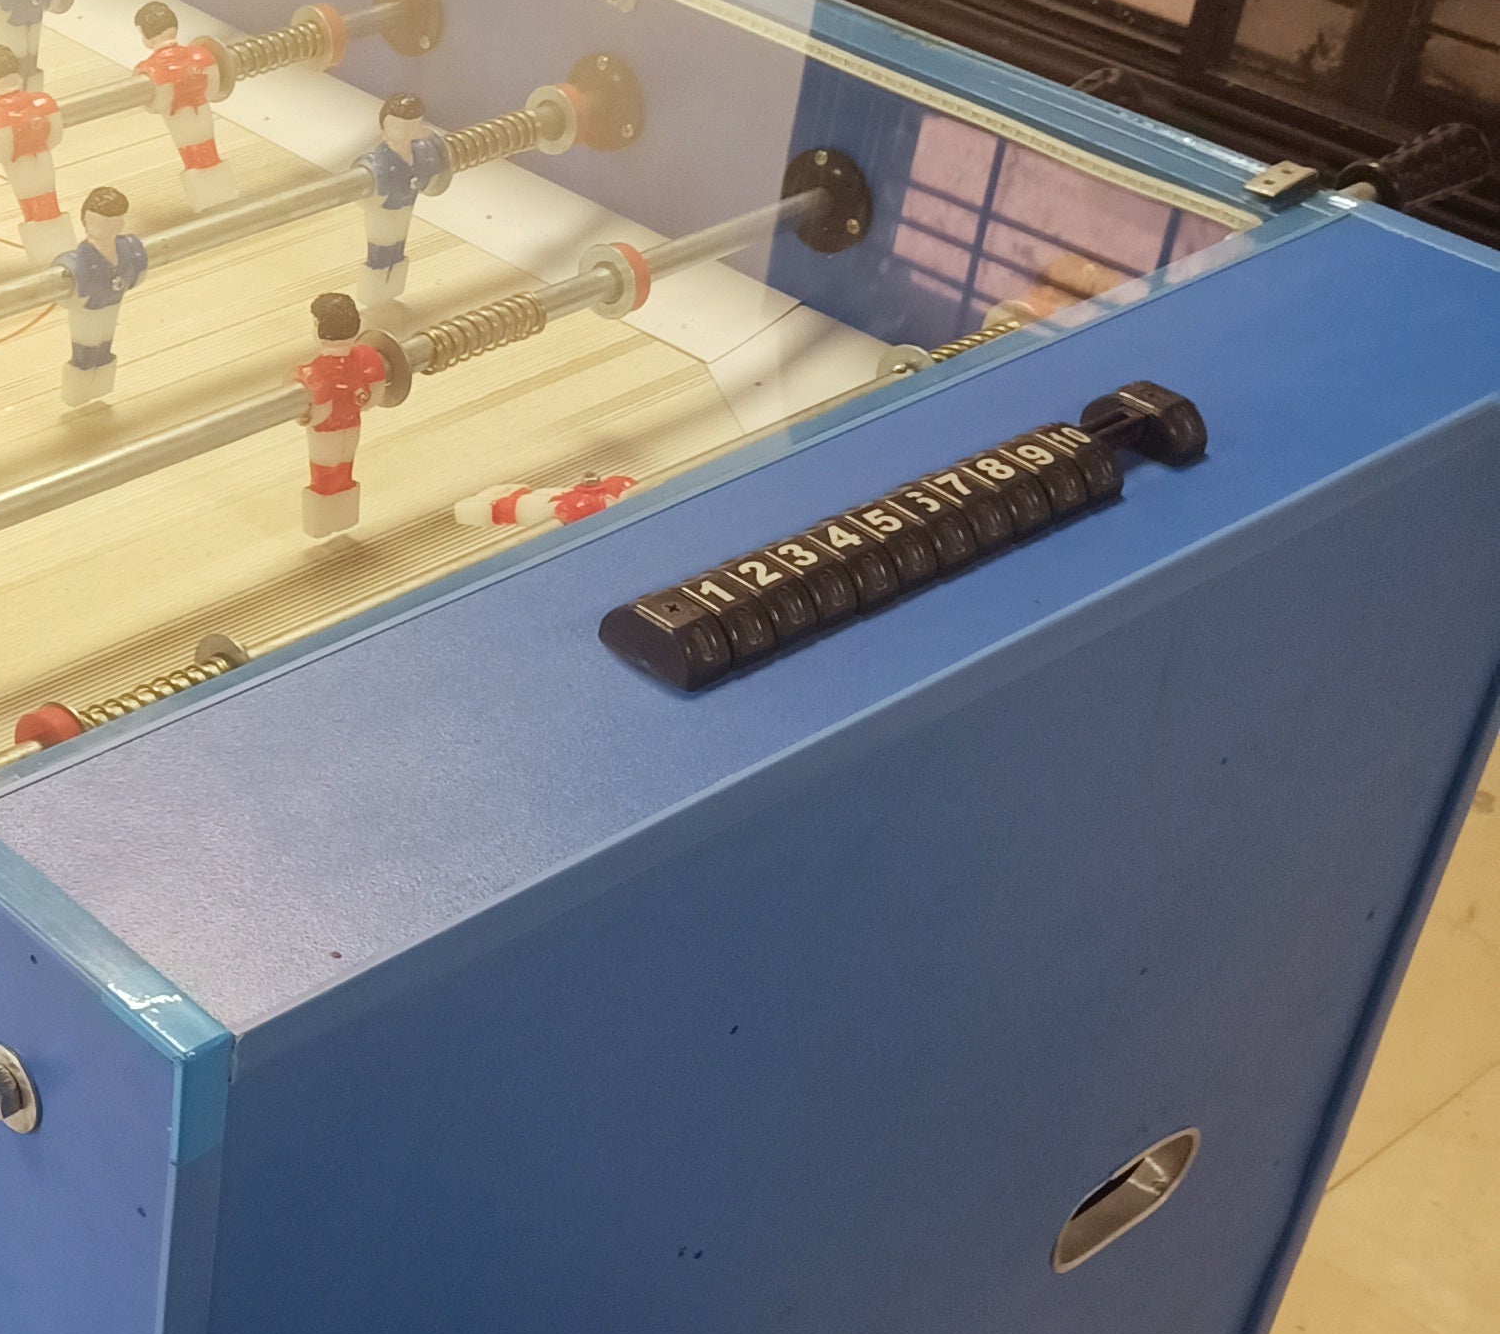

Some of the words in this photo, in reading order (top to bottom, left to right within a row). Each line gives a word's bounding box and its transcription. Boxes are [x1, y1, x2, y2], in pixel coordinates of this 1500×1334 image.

[699, 580, 736, 602] 1
[738, 561, 783, 587] 2
[777, 543, 819, 567] 3
[827, 525, 863, 549] 4
[862, 508, 903, 532] 5
[933, 472, 972, 496] 7
[975, 457, 1016, 480] 8
[1016, 444, 1055, 465] 9
[1049, 426, 1092, 449] 10
